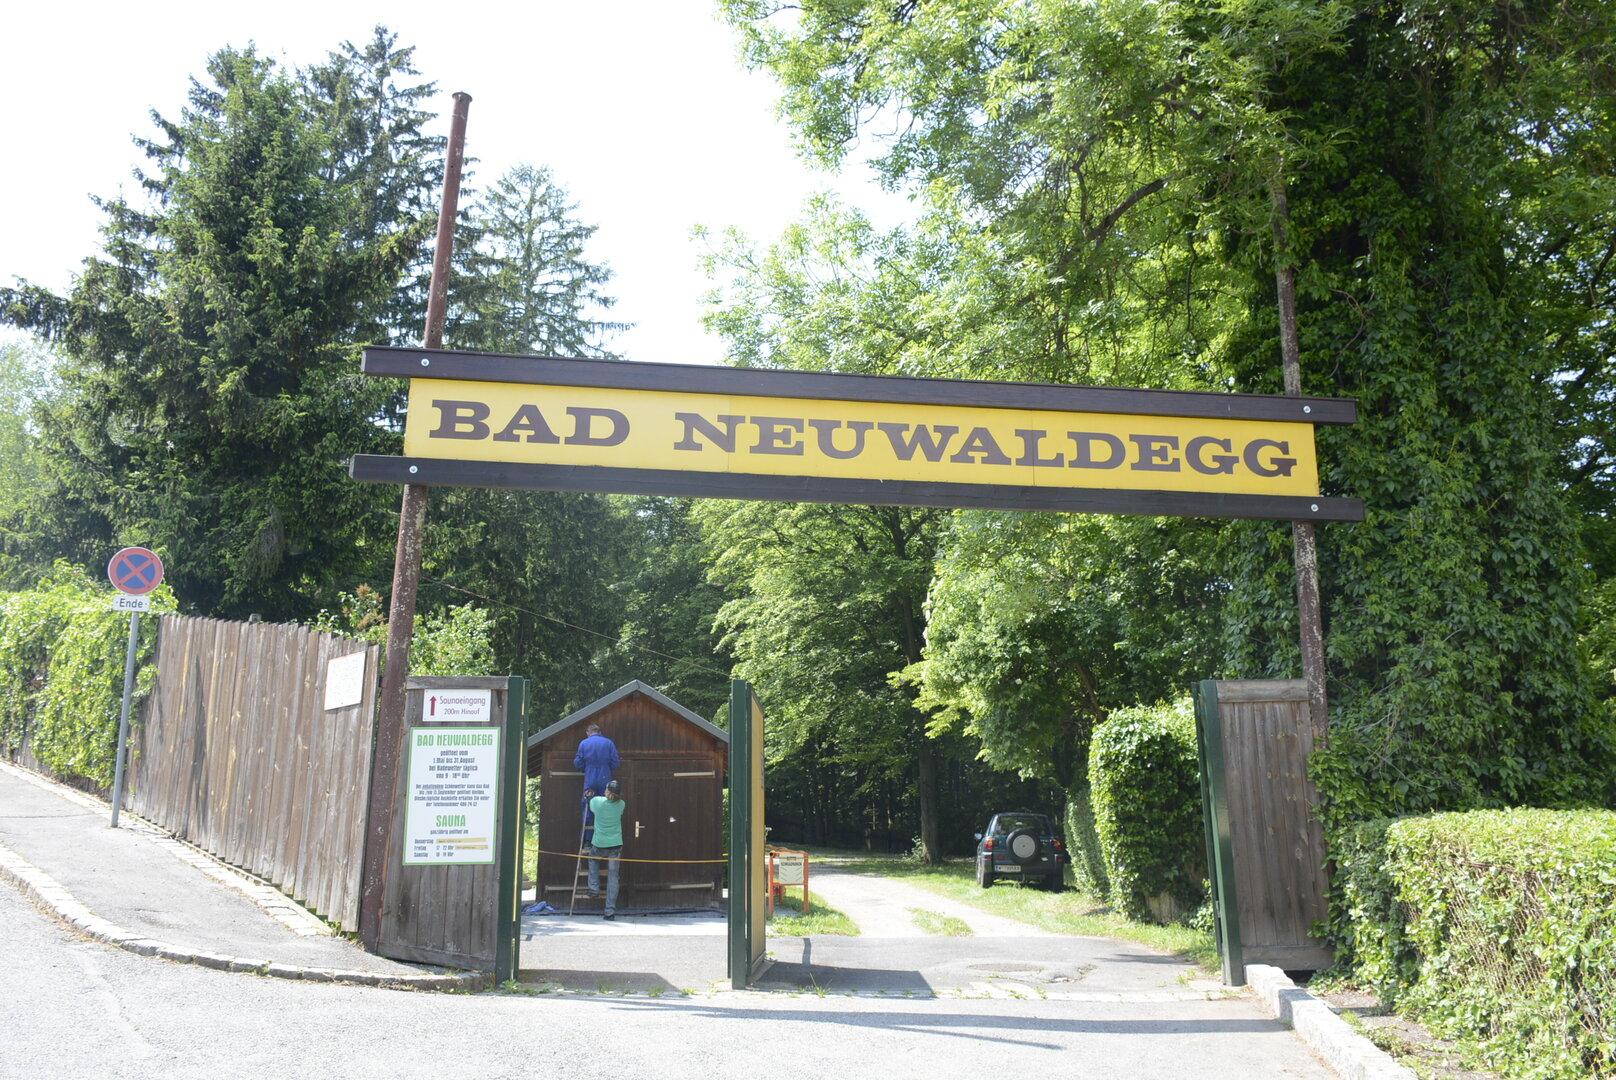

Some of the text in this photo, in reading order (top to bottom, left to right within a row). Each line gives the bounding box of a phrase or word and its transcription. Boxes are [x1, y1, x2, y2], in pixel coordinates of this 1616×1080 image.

[428, 399, 1297, 478] BAD NEUWALDEGG
[119, 598, 144, 608] Ende
[440, 696, 486, 706] Saunaeingang
[417, 734, 493, 746] BAD NEUWALDEGG
[436, 815, 466, 827] SAUNA
